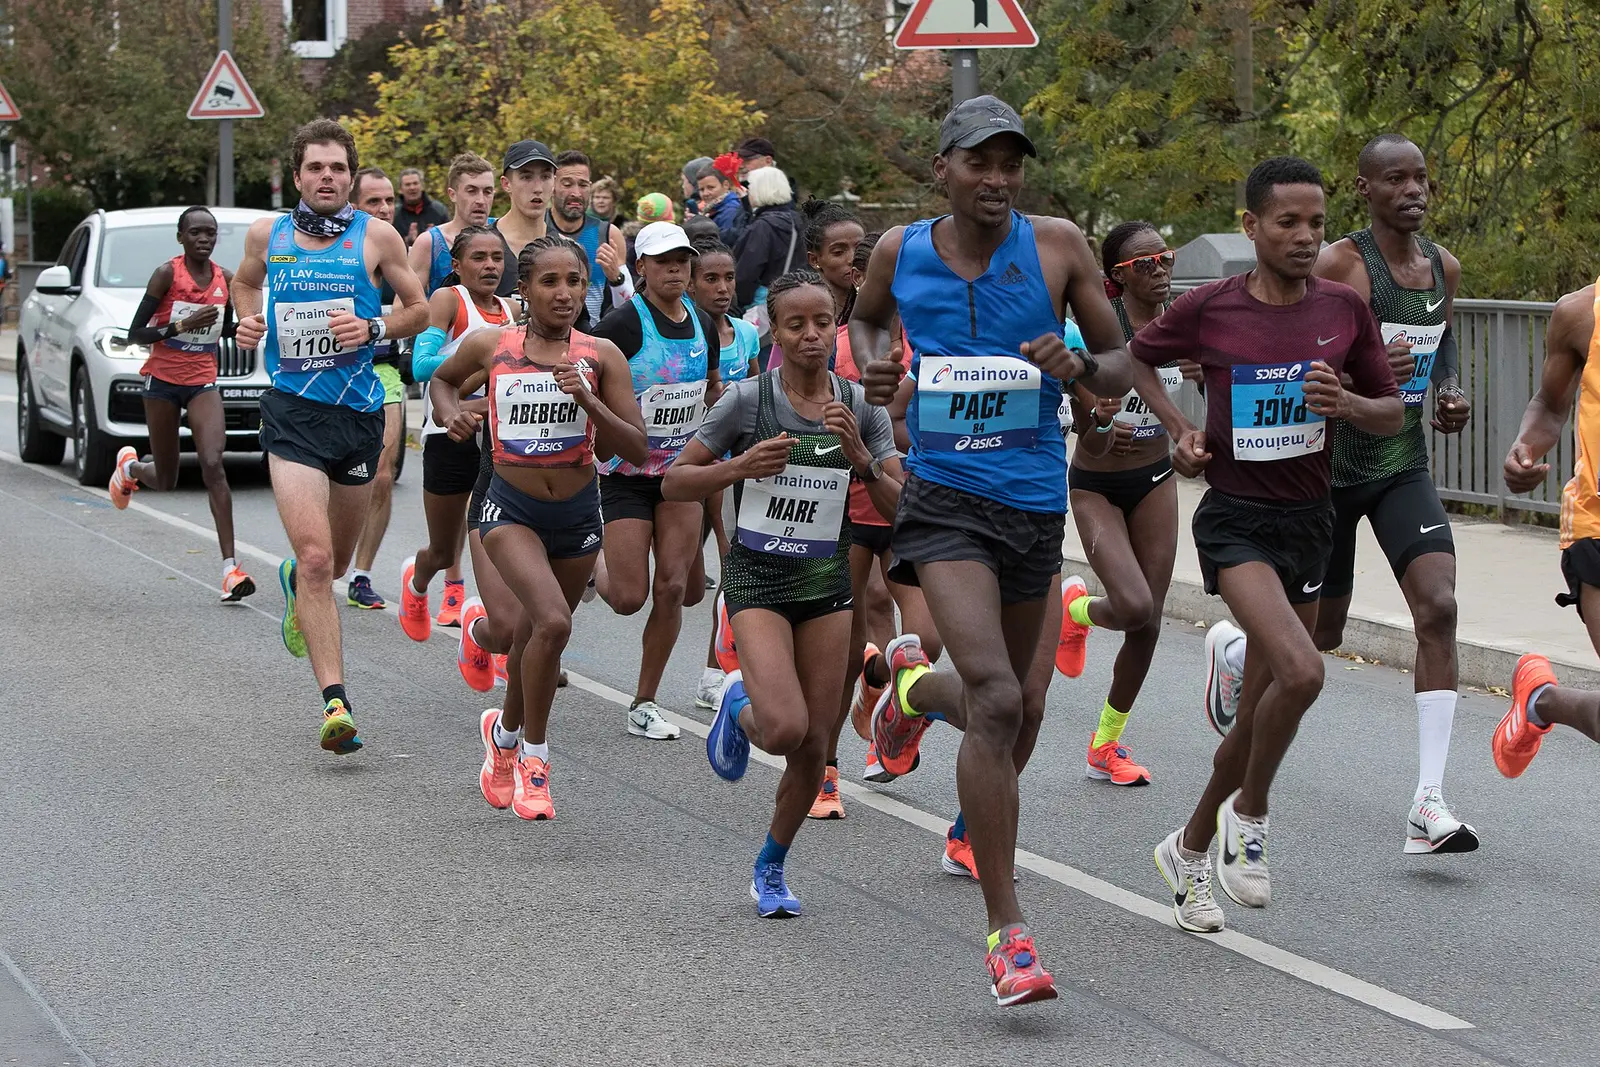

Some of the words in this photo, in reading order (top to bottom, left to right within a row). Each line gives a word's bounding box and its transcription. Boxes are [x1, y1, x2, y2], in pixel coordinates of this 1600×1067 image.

[290, 269, 313, 279] LAV
[314, 272, 355, 280] Stadtwerke
[290, 281, 355, 292] TÜBINGEN
[301, 328, 330, 336] Lorenz
[311, 358, 335, 369] asics
[954, 366, 1028, 381] mainova
[1255, 367, 1287, 380] asics
[223, 389, 241, 397] DER
[664, 387, 702, 401] mainova
[1275, 384, 1285, 395] 72
[1403, 393, 1422, 403] asics
[949, 392, 1008, 420] PACE
[1253, 396, 1307, 426] PACE
[509, 402, 578, 425] ABEBECH
[653, 404, 696, 425] BEDATU
[1140, 417, 1149, 426] F6
[540, 428, 550, 438] F9
[972, 422, 985, 434] 84
[1136, 428, 1156, 438] asics
[537, 441, 563, 452] asics
[970, 436, 1003, 449] asics
[1236, 434, 1305, 450] mainova
[774, 474, 838, 491] mainova
[766, 496, 819, 523] MARE
[783, 526, 795, 537] F2
[779, 541, 808, 554] asics
